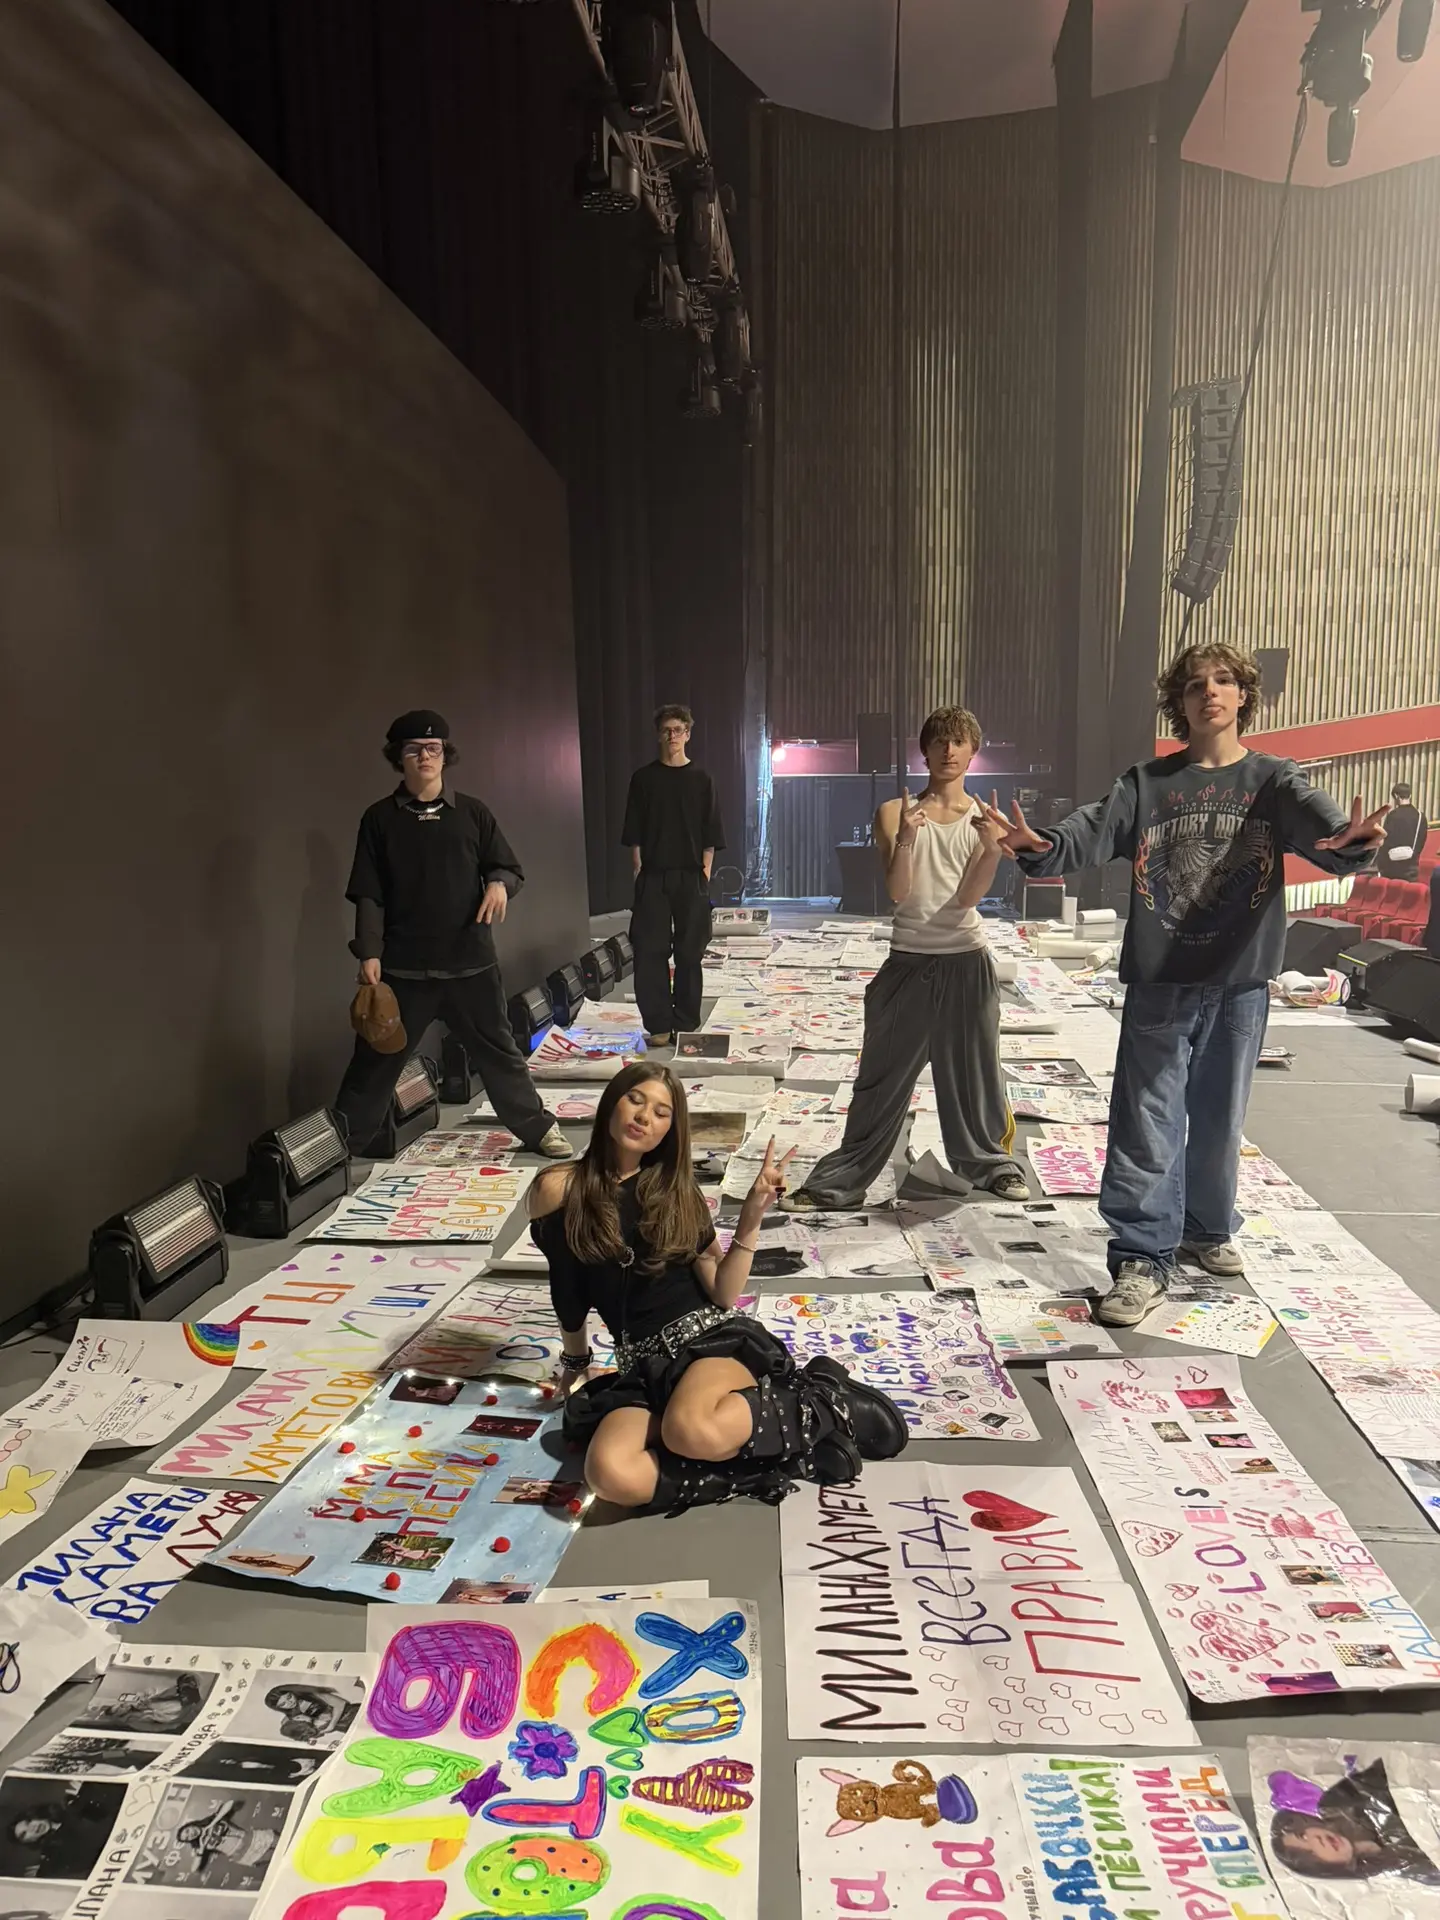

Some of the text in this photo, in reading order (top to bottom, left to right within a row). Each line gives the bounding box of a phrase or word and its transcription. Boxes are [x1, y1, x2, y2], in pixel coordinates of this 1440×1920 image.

[1147, 813, 1209, 851] VICTORY
[322, 1173, 427, 1238] МИЛАНА
[387, 1167, 475, 1238] ХАМЕТОВА
[228, 1280, 356, 1327] ТЫ
[291, 1256, 471, 1369] ЛУЧШАЯ
[159, 1367, 328, 1474] МИЛАНА
[230, 1369, 386, 1479] ХАМЕТОВА
[312, 1451, 400, 1520] МАМА
[366, 1451, 448, 1519] КУПИ
[1182, 1508, 1267, 1595] LOVE
[993, 1529, 1141, 1683] ПРАВА
[633, 1609, 755, 1875] ХОЧУ
[71, 1849, 131, 1920] ИЛАНА
